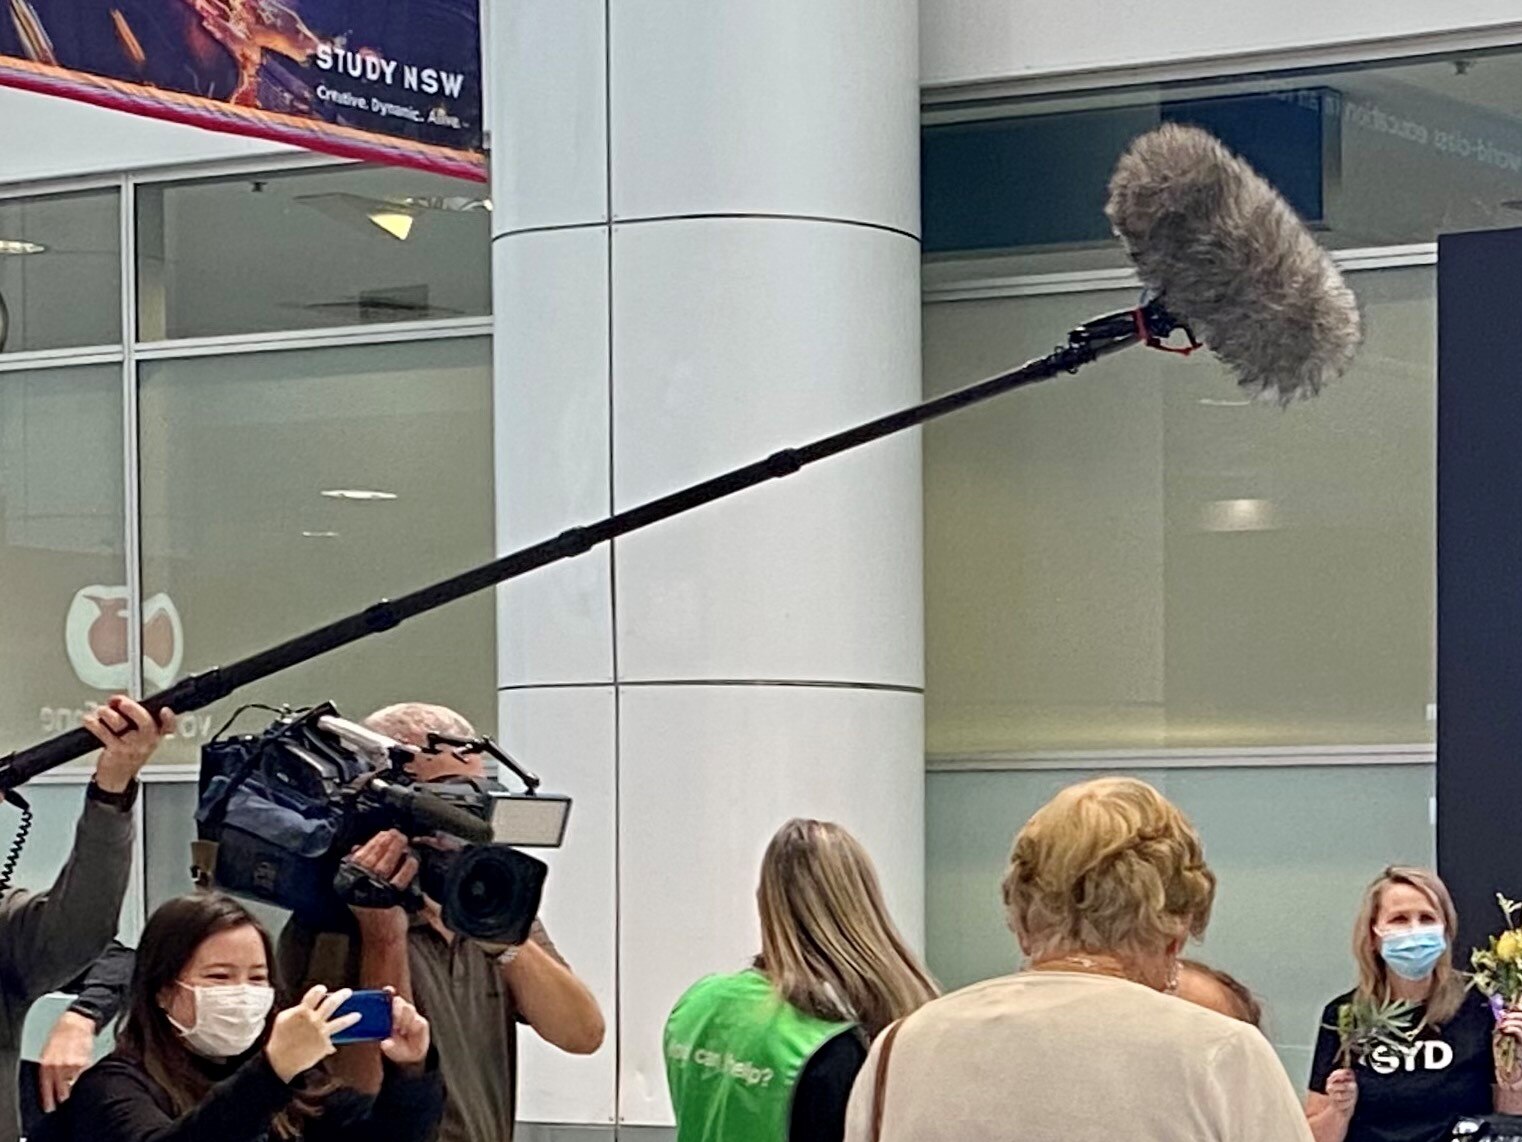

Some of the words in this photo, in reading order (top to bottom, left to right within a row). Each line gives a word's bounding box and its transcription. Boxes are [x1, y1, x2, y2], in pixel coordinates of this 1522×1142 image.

[316, 44, 397, 85] STUDY
[403, 65, 464, 99] NSW
[316, 85, 369, 110] Creative.
[371, 98, 425, 122] Dynamic.
[1371, 1040, 1454, 1075] SYD
